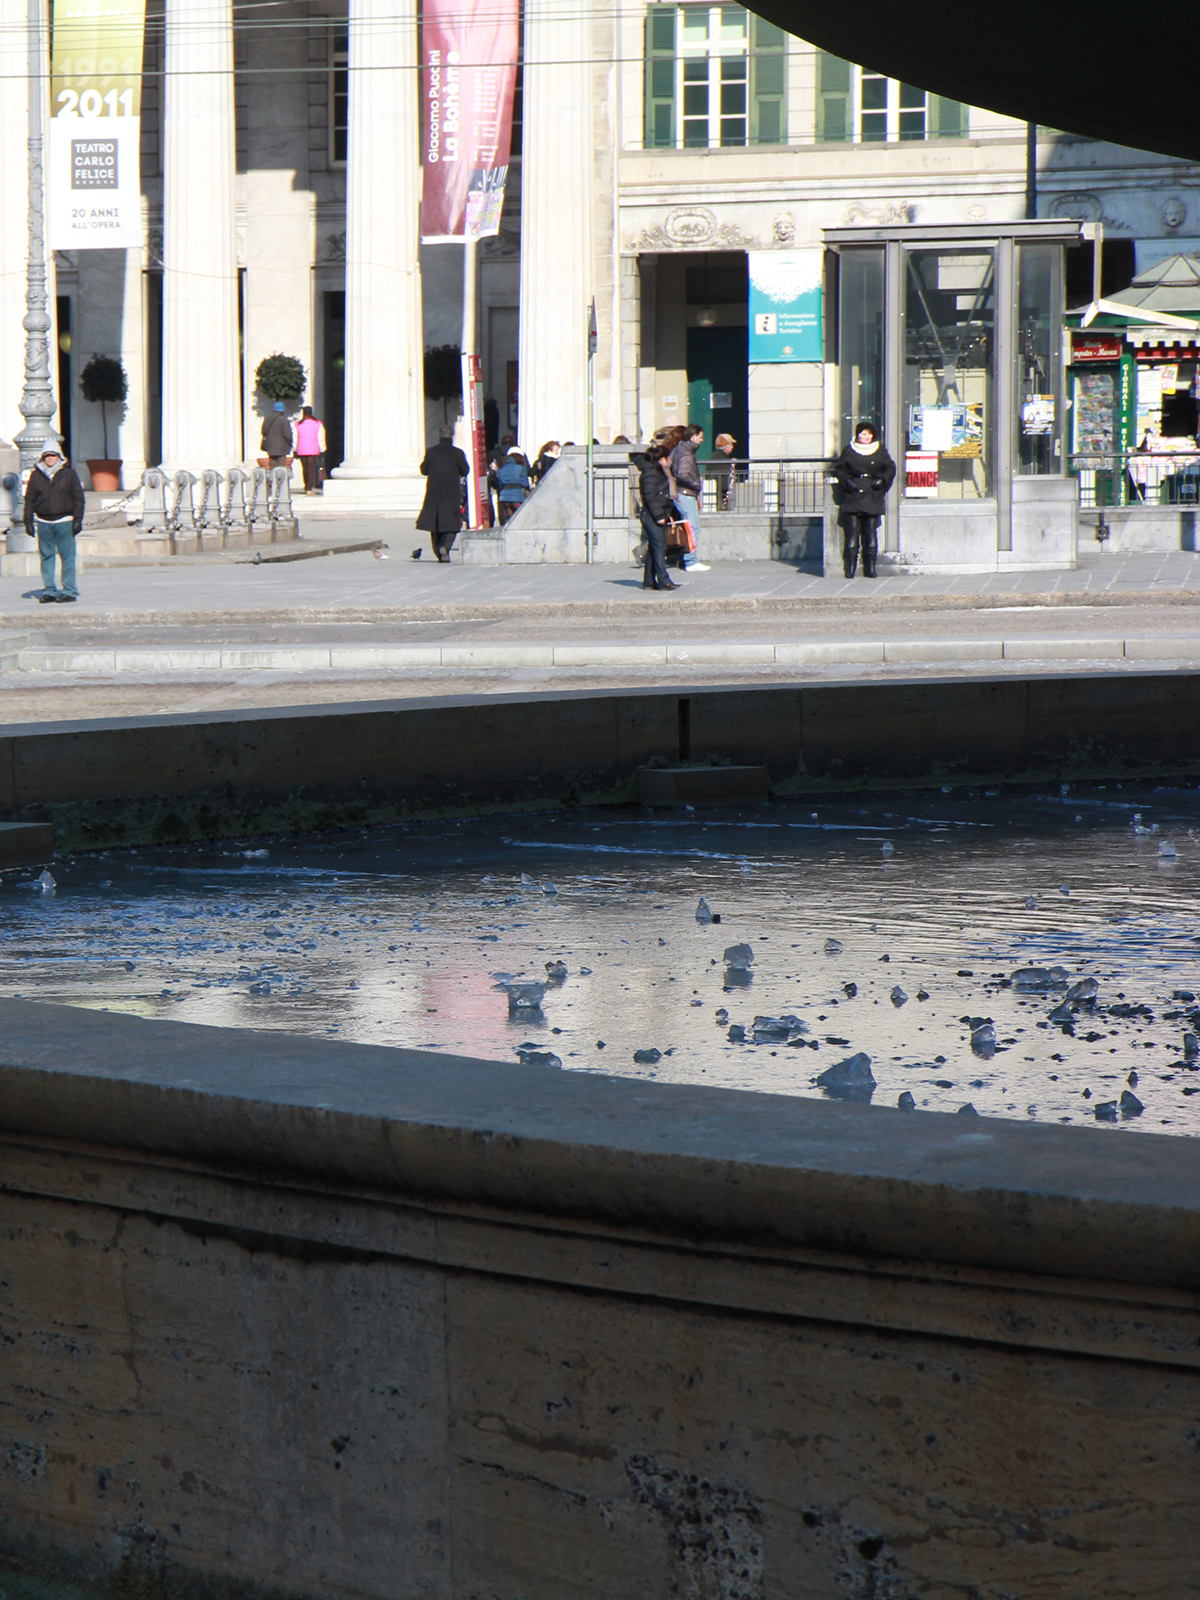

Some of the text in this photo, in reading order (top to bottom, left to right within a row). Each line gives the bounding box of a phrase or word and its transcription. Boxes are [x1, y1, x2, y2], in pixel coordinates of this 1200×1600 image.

[58, 57, 134, 87] 1991
[57, 88, 133, 117] 2011
[428, 49, 441, 163] Giacomo Puccini
[74, 143, 115, 153] TEATRO
[442, 137, 459, 162] La
[74, 156, 115, 166] CARLO
[74, 169, 115, 179] FELICE
[71, 208, 119, 218] 20 ANNI
[71, 221, 121, 229] ALL'OPERA
[907, 472, 939, 487] DANCE
